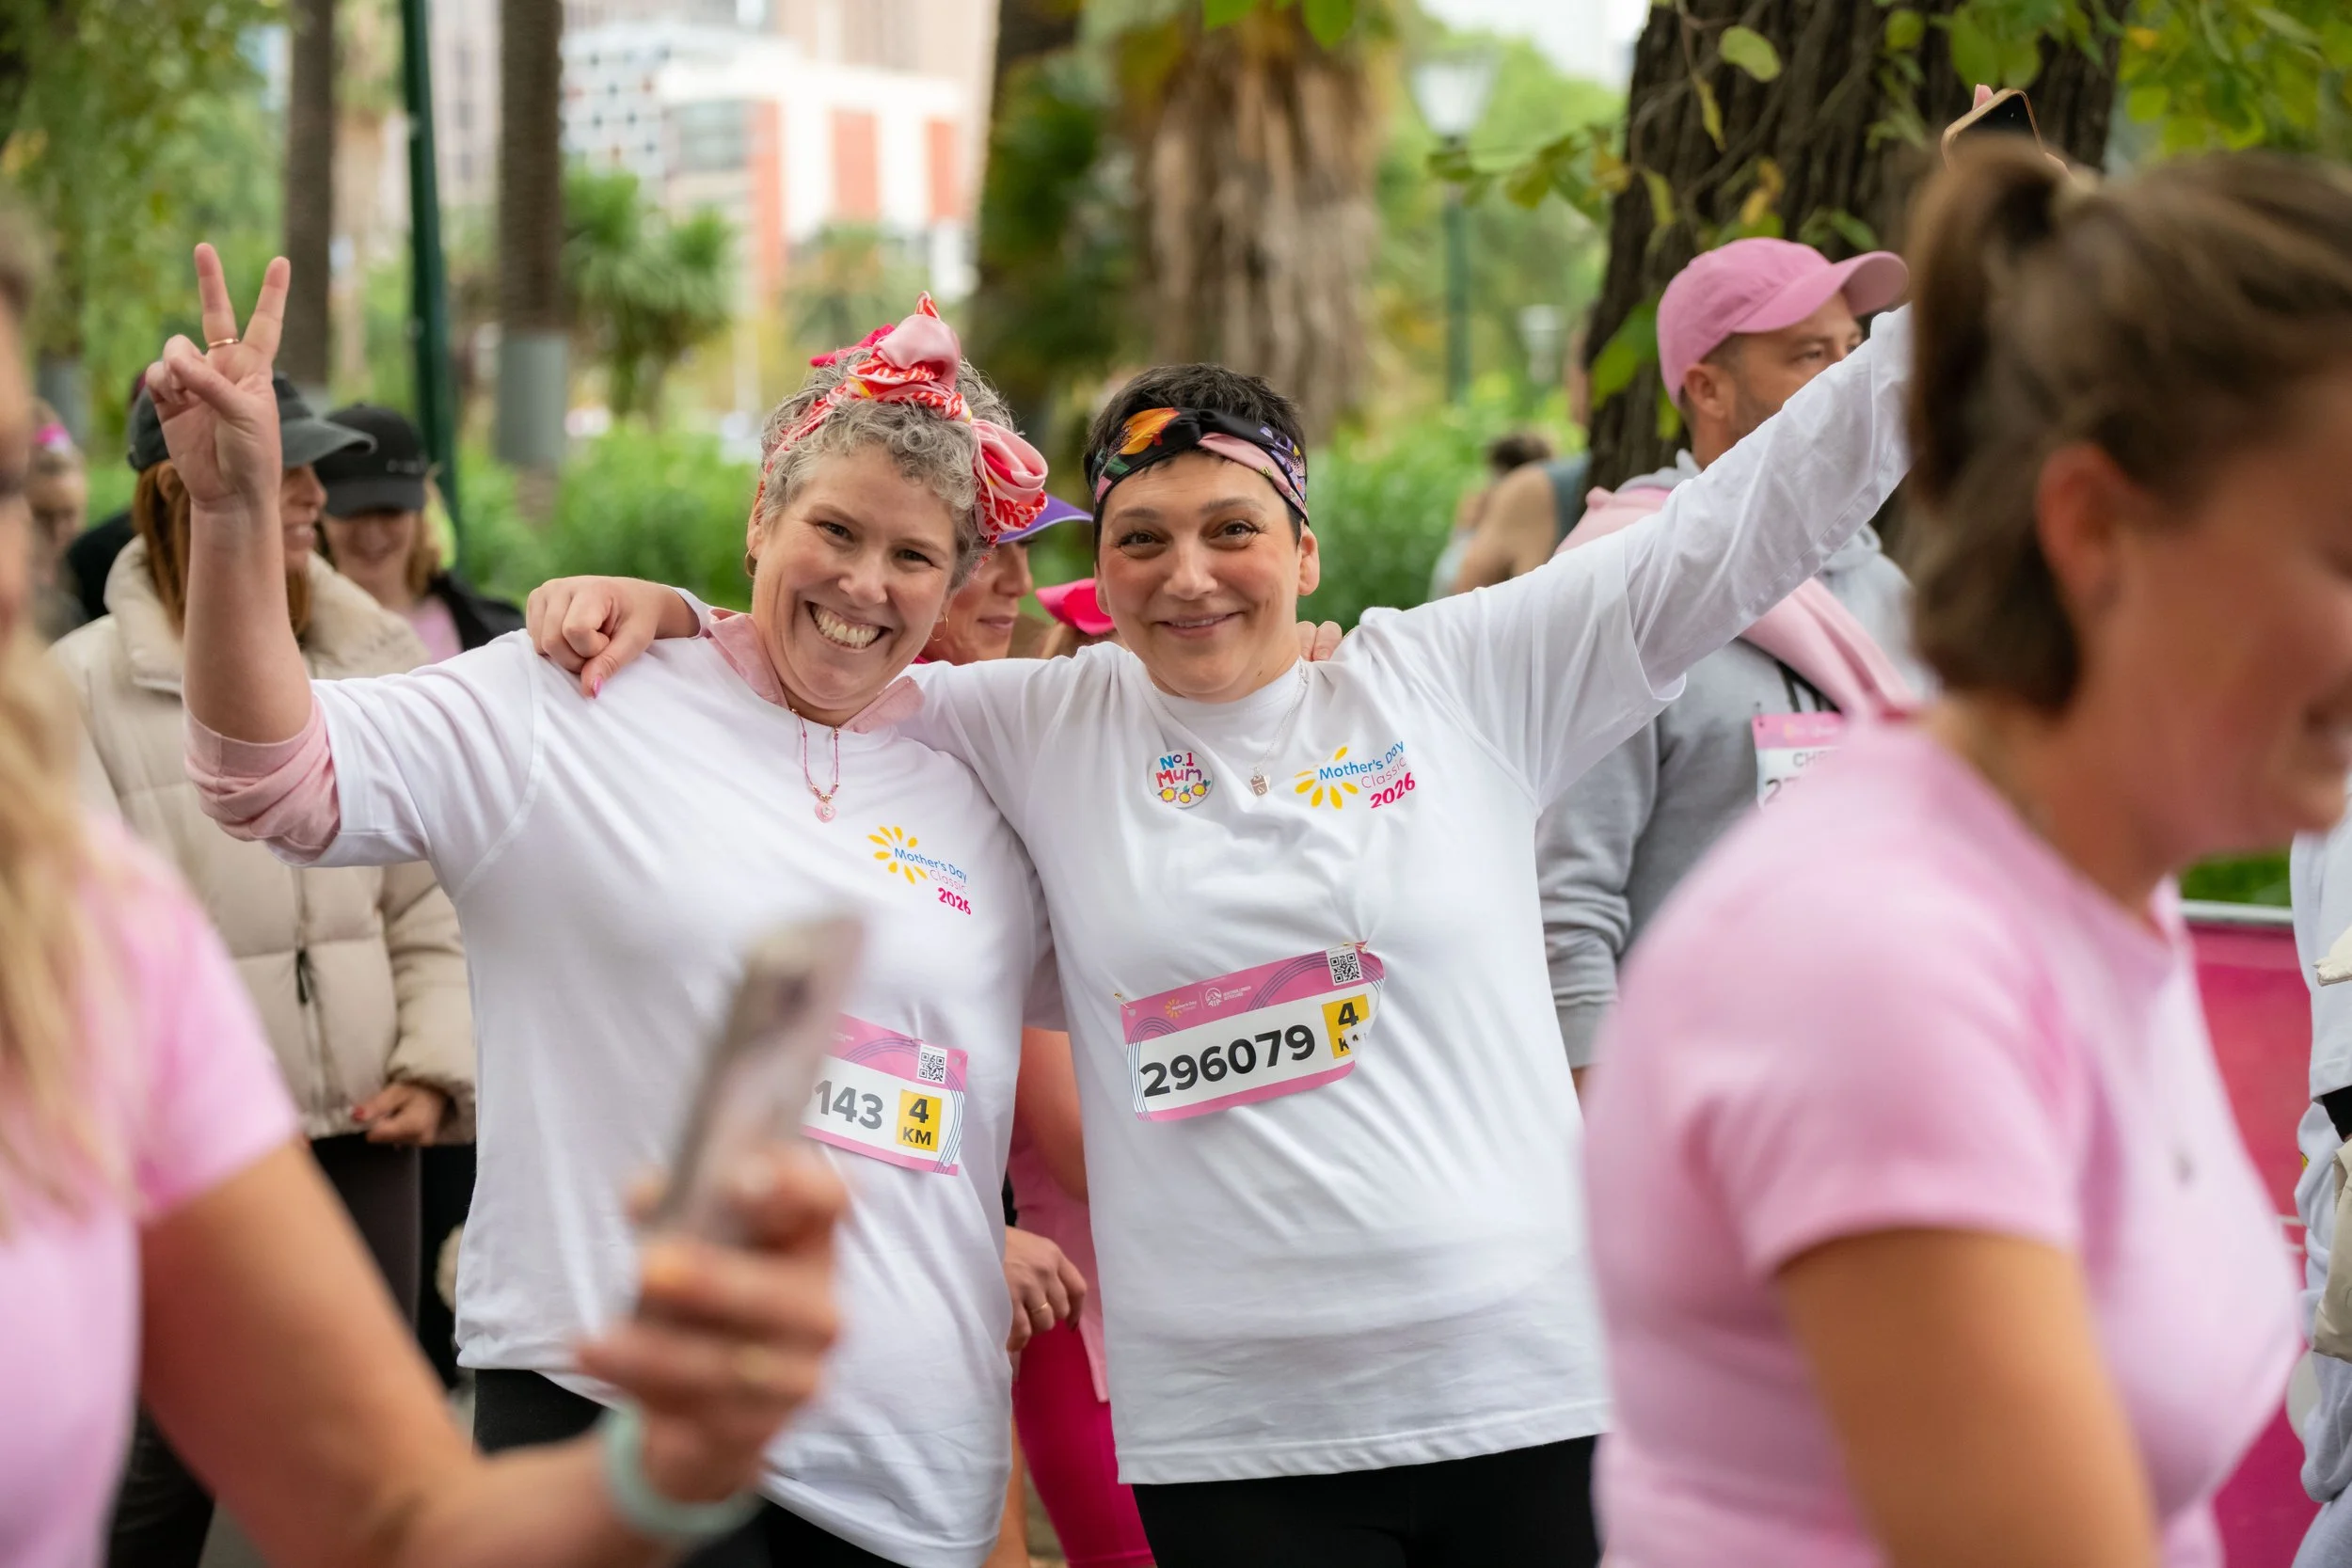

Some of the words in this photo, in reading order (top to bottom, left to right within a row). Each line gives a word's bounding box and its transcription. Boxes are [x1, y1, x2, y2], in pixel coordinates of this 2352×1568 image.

[1159, 752, 1195, 770] No.1
[1319, 759, 1384, 781] Mother's
[1385, 740, 1405, 764] Day
[1361, 756, 1406, 788] Classic
[1155, 768, 1202, 787] Mum
[1370, 771, 1416, 809] 2026
[894, 847, 947, 872] Mother's
[948, 863, 967, 883] Day
[930, 869, 970, 895] Classic
[938, 887, 972, 915] 2026
[1338, 1002, 1359, 1027] 4
[1139, 1024, 1315, 1098] 296079
[909, 1098, 930, 1124] 4
[902, 1126, 932, 1146] KM
